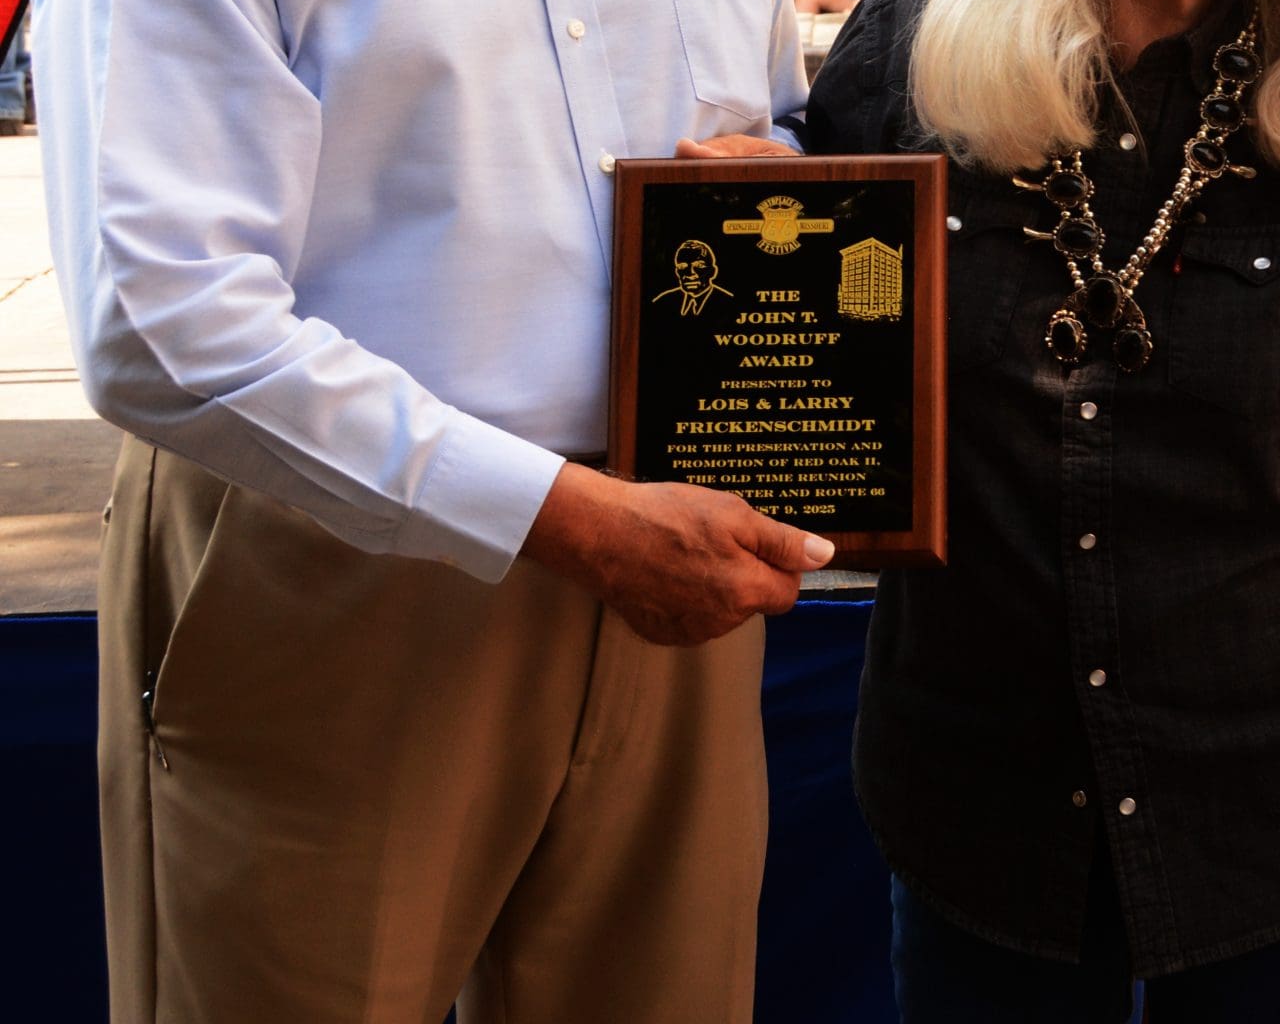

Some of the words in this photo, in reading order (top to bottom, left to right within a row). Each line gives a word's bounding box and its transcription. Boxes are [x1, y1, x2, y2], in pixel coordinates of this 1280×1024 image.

[757, 239, 802, 255] FESTIVAL
[756, 290, 800, 303] THE
[735, 311, 796, 324] JOHN
[800, 311, 818, 323] T.
[714, 332, 841, 346] WOODRUFF
[739, 355, 814, 368] AWARD
[720, 379, 807, 389] PRESENTED
[811, 379, 832, 388] TO
[698, 398, 749, 411] LOIS
[755, 399, 772, 410] &
[779, 396, 854, 410] LARRY
[675, 419, 876, 434] FRICKENSCHMIDT
[667, 444, 697, 453] FOR
[702, 444, 732, 453] THE
[736, 442, 846, 452] PRESERVATION
[851, 441, 883, 451] AND
[672, 458, 764, 469] PROMOTION
[768, 458, 789, 467] OF
[793, 458, 824, 467] RED
[828, 457, 860, 466] OAK
[686, 474, 716, 484] THE
[720, 474, 751, 483] OLD
[755, 473, 794, 483] TIME
[798, 472, 867, 482] REUNION
[728, 489, 774, 498] NTER
[779, 488, 810, 498] AND
[815, 488, 867, 497] ROUTE
[870, 487, 886, 496] 66
[784, 505, 798, 515] 9,
[802, 504, 836, 514] 2025
